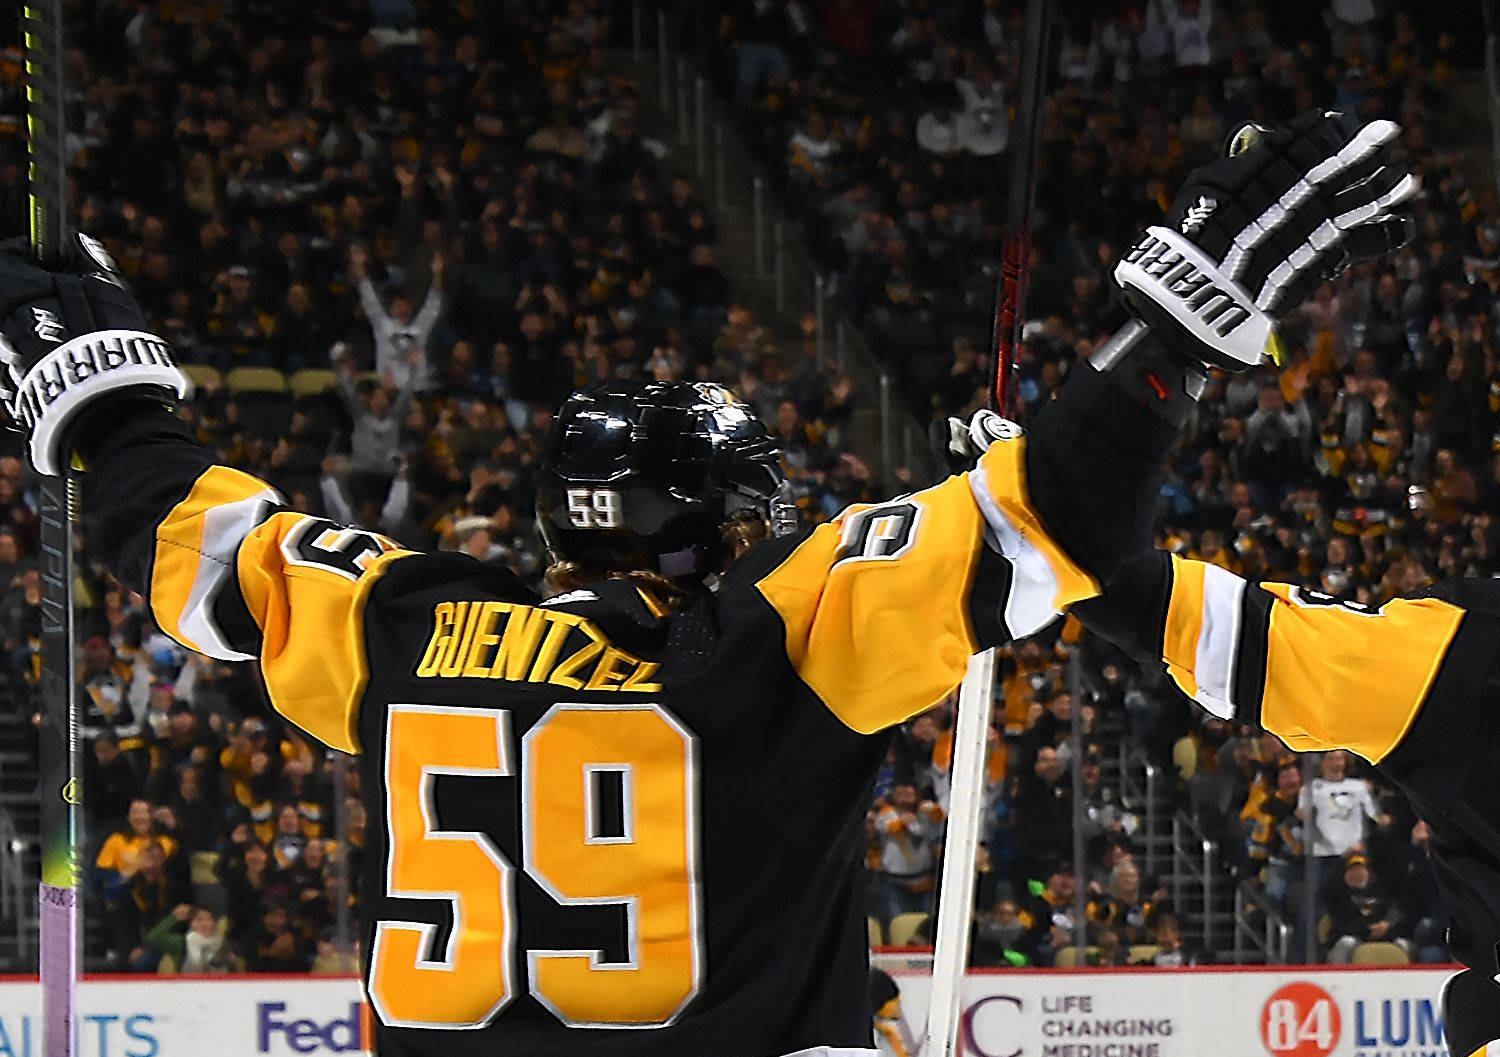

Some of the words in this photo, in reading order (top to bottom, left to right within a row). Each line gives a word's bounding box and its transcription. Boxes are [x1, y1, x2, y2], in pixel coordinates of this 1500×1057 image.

[567, 489, 623, 529] 59
[417, 601, 664, 693] GUENTZEL
[367, 702, 702, 1029] 59
[1041, 995, 1093, 1014] LIFE
[1041, 1018, 1173, 1037] CHANGING
[1267, 998, 1334, 1051] 84
[1354, 999, 1446, 1047] LUM
